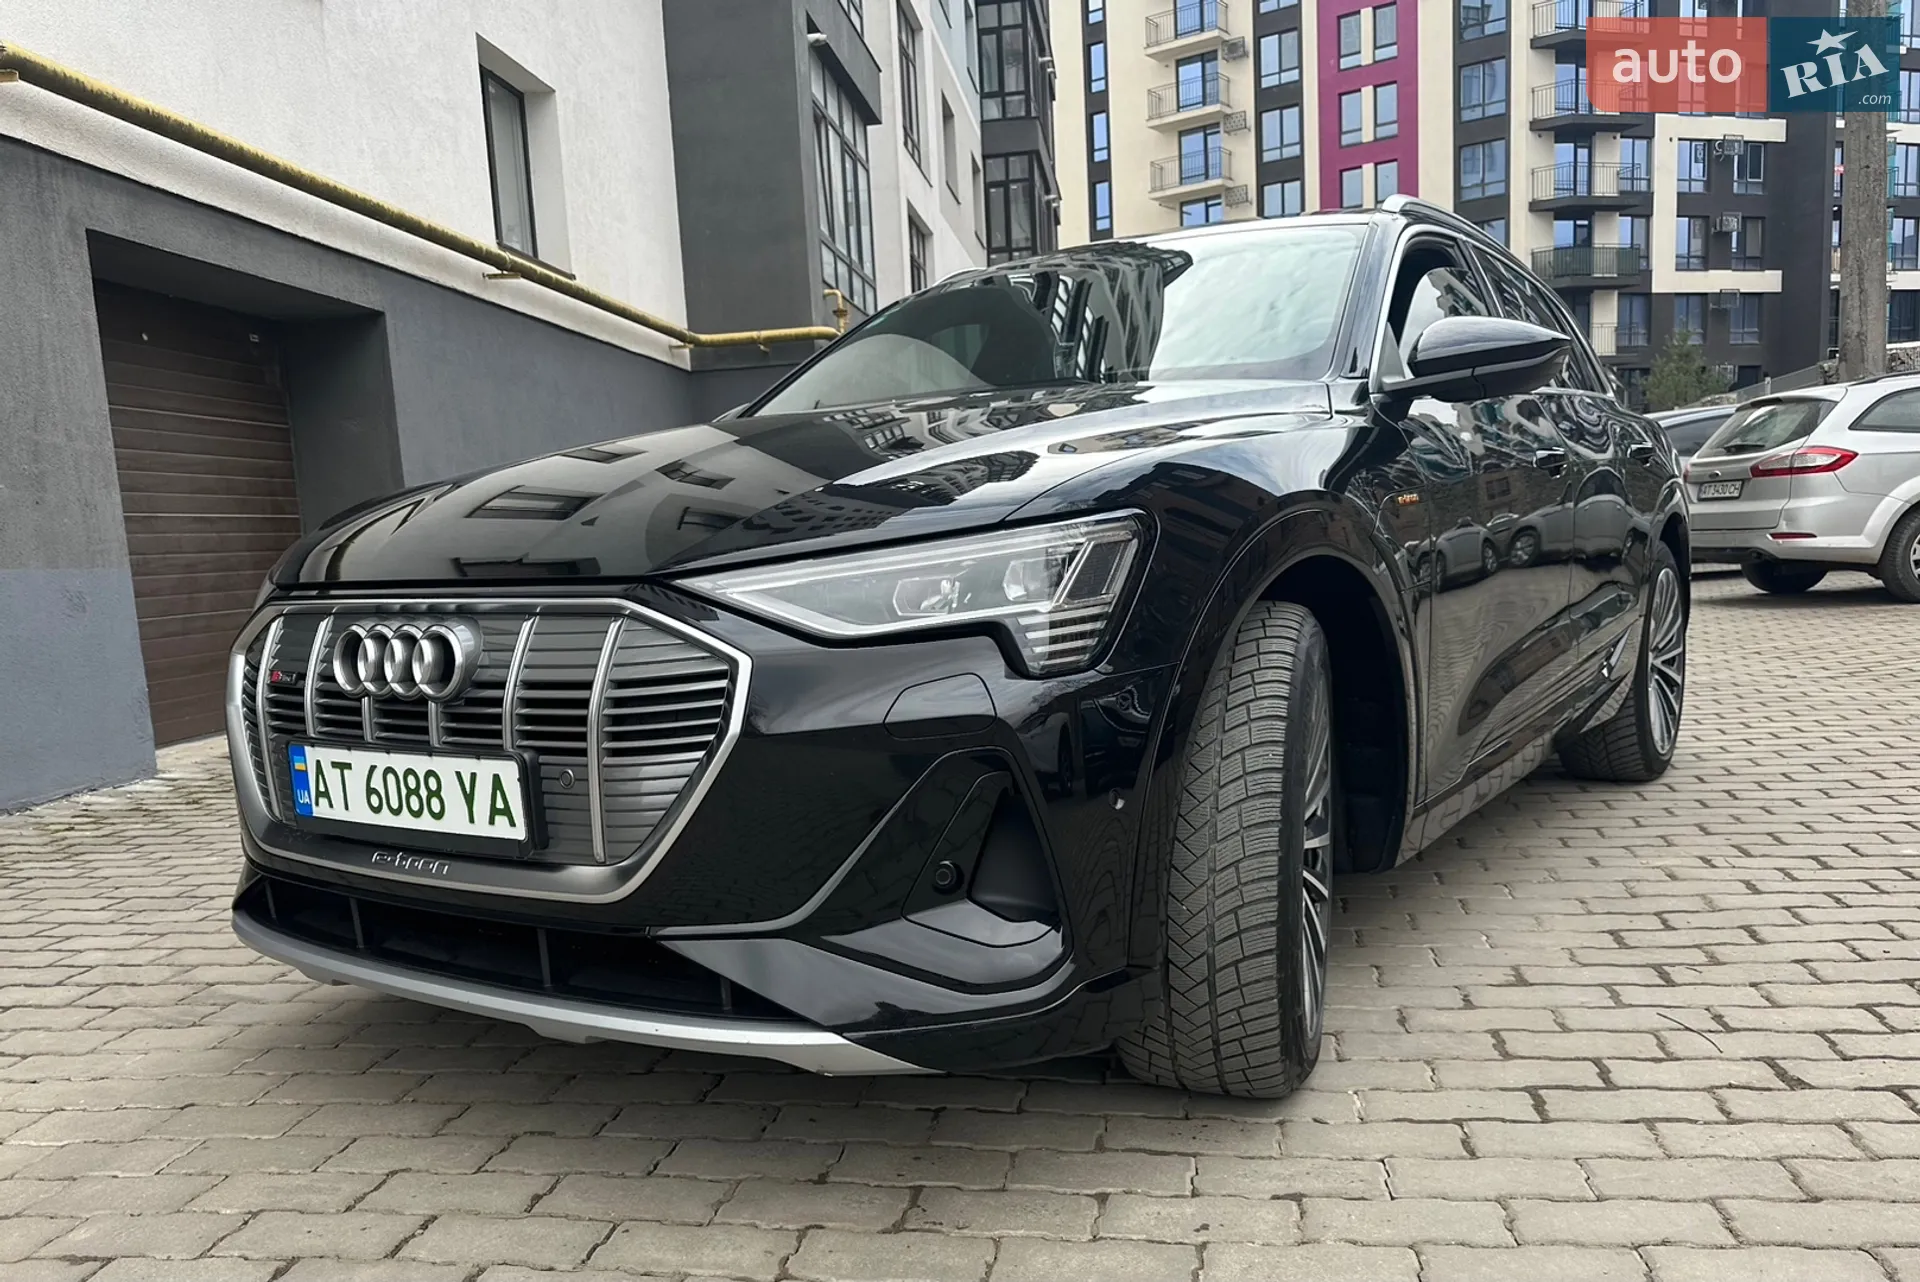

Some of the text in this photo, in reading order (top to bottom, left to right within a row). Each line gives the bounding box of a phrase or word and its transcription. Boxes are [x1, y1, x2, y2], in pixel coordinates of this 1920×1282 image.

[297, 788, 311, 804] UA
[314, 759, 517, 828] AT 6088 YA
